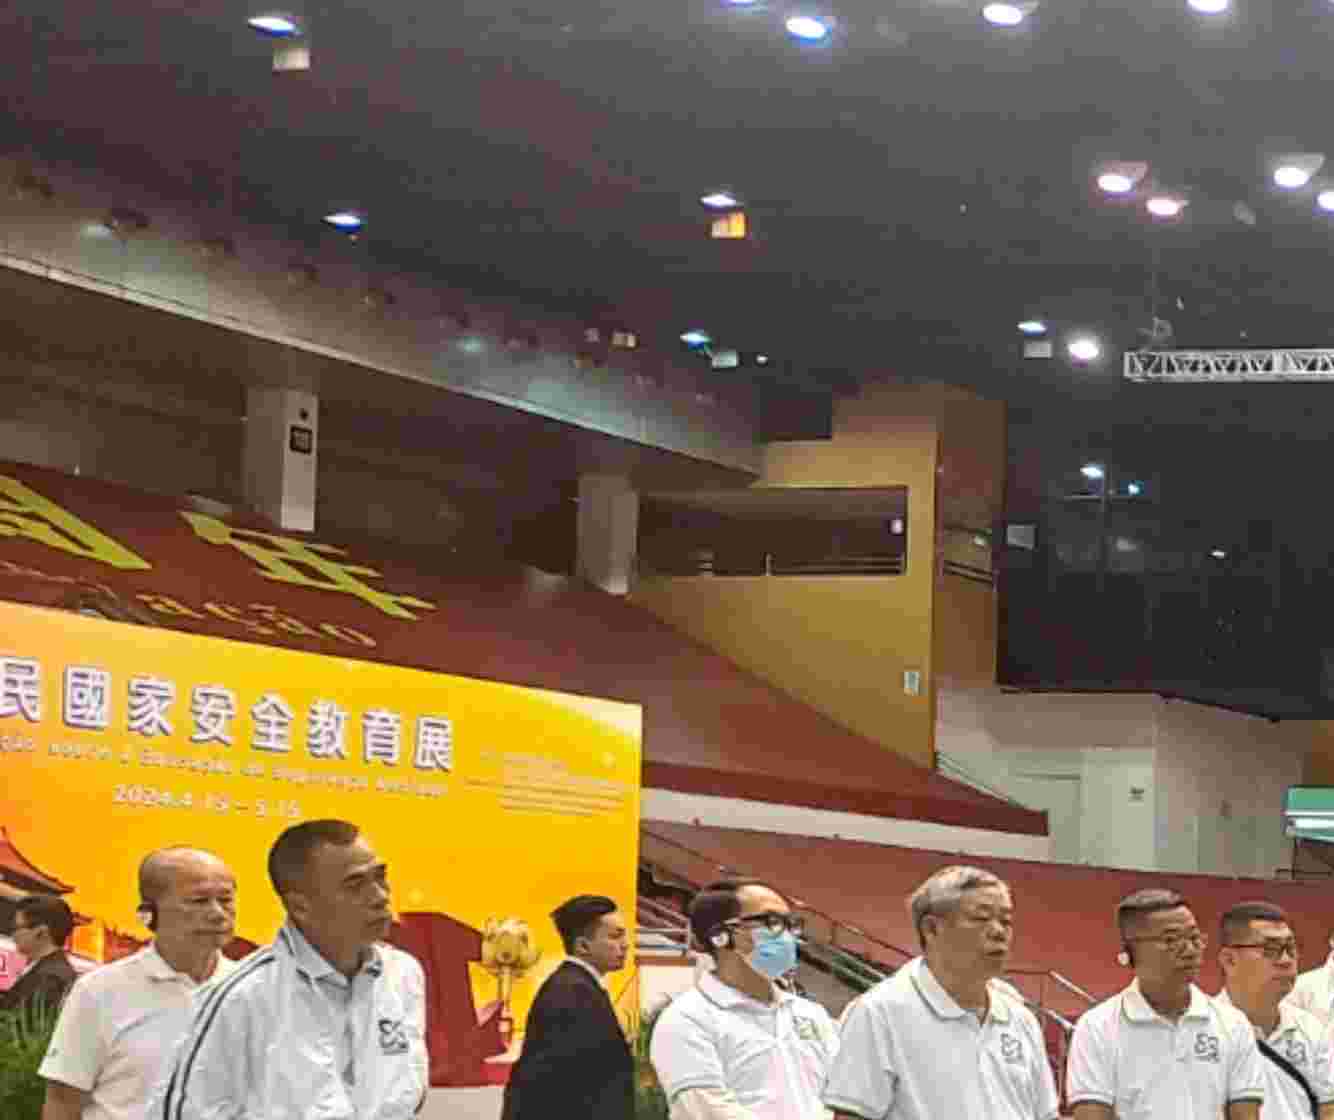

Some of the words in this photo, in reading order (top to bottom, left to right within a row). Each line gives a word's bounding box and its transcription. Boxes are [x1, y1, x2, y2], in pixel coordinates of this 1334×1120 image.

[0, 655, 454, 772] 民國家安全教育展
